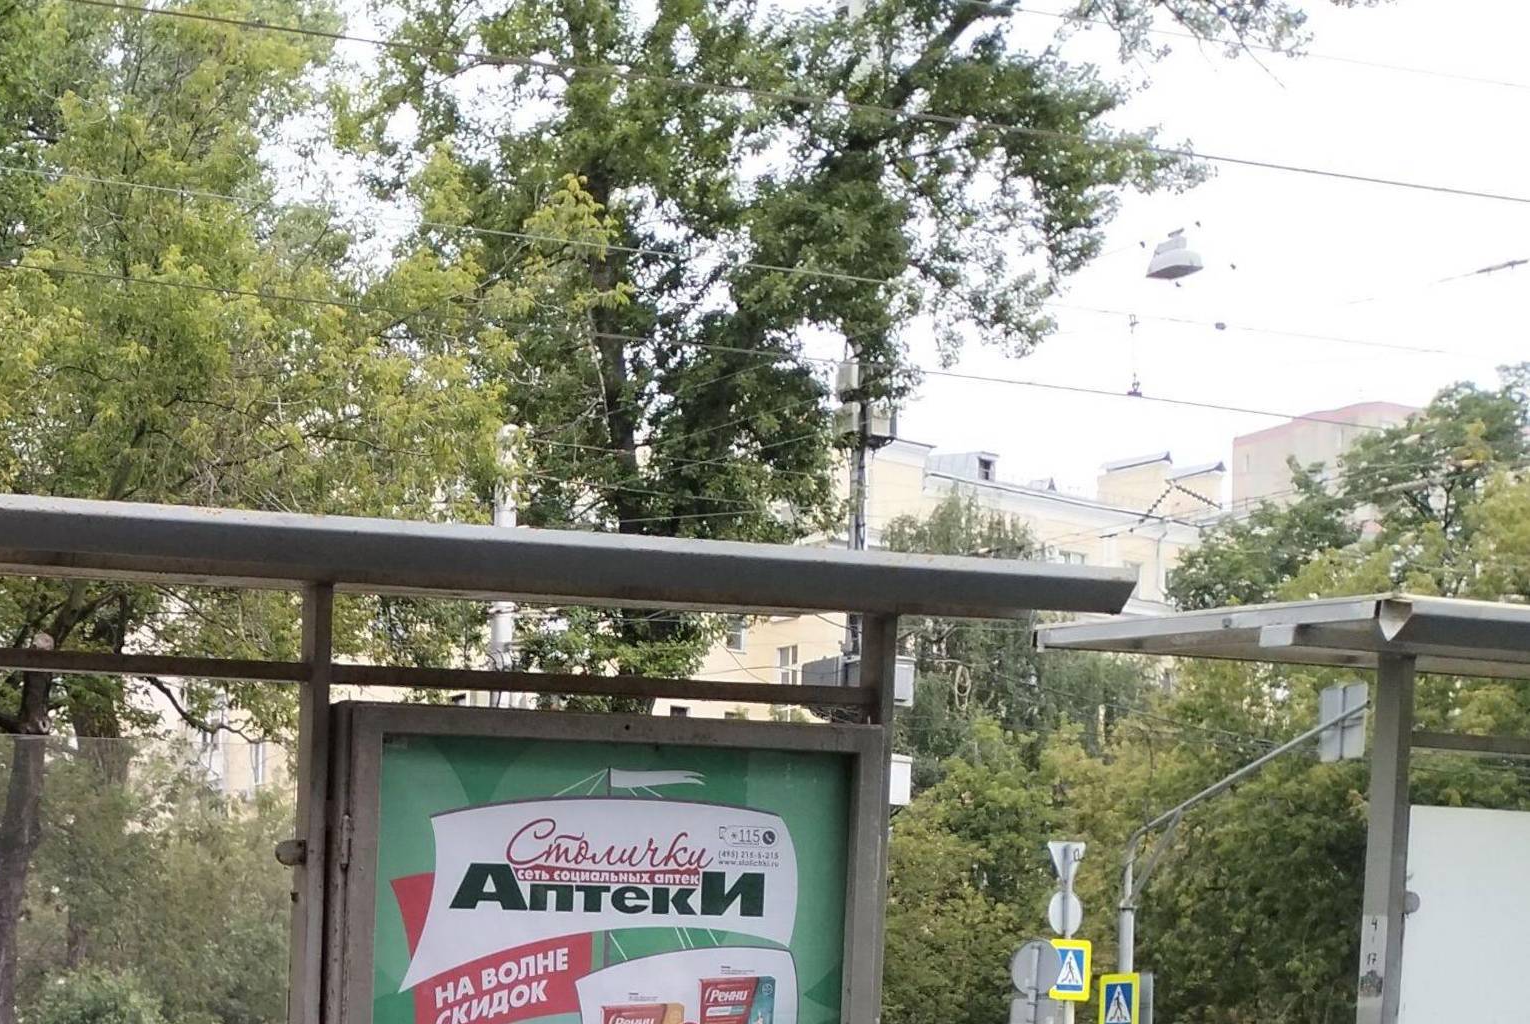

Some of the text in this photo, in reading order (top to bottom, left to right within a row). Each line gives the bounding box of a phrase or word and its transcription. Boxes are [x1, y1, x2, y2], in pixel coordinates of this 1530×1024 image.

[506, 818, 713, 868] Столички
[518, 869, 700, 885] сеть социальных аптек
[434, 947, 569, 1009] НА ВОЛНЕ
[707, 987, 749, 1003] Ренни
